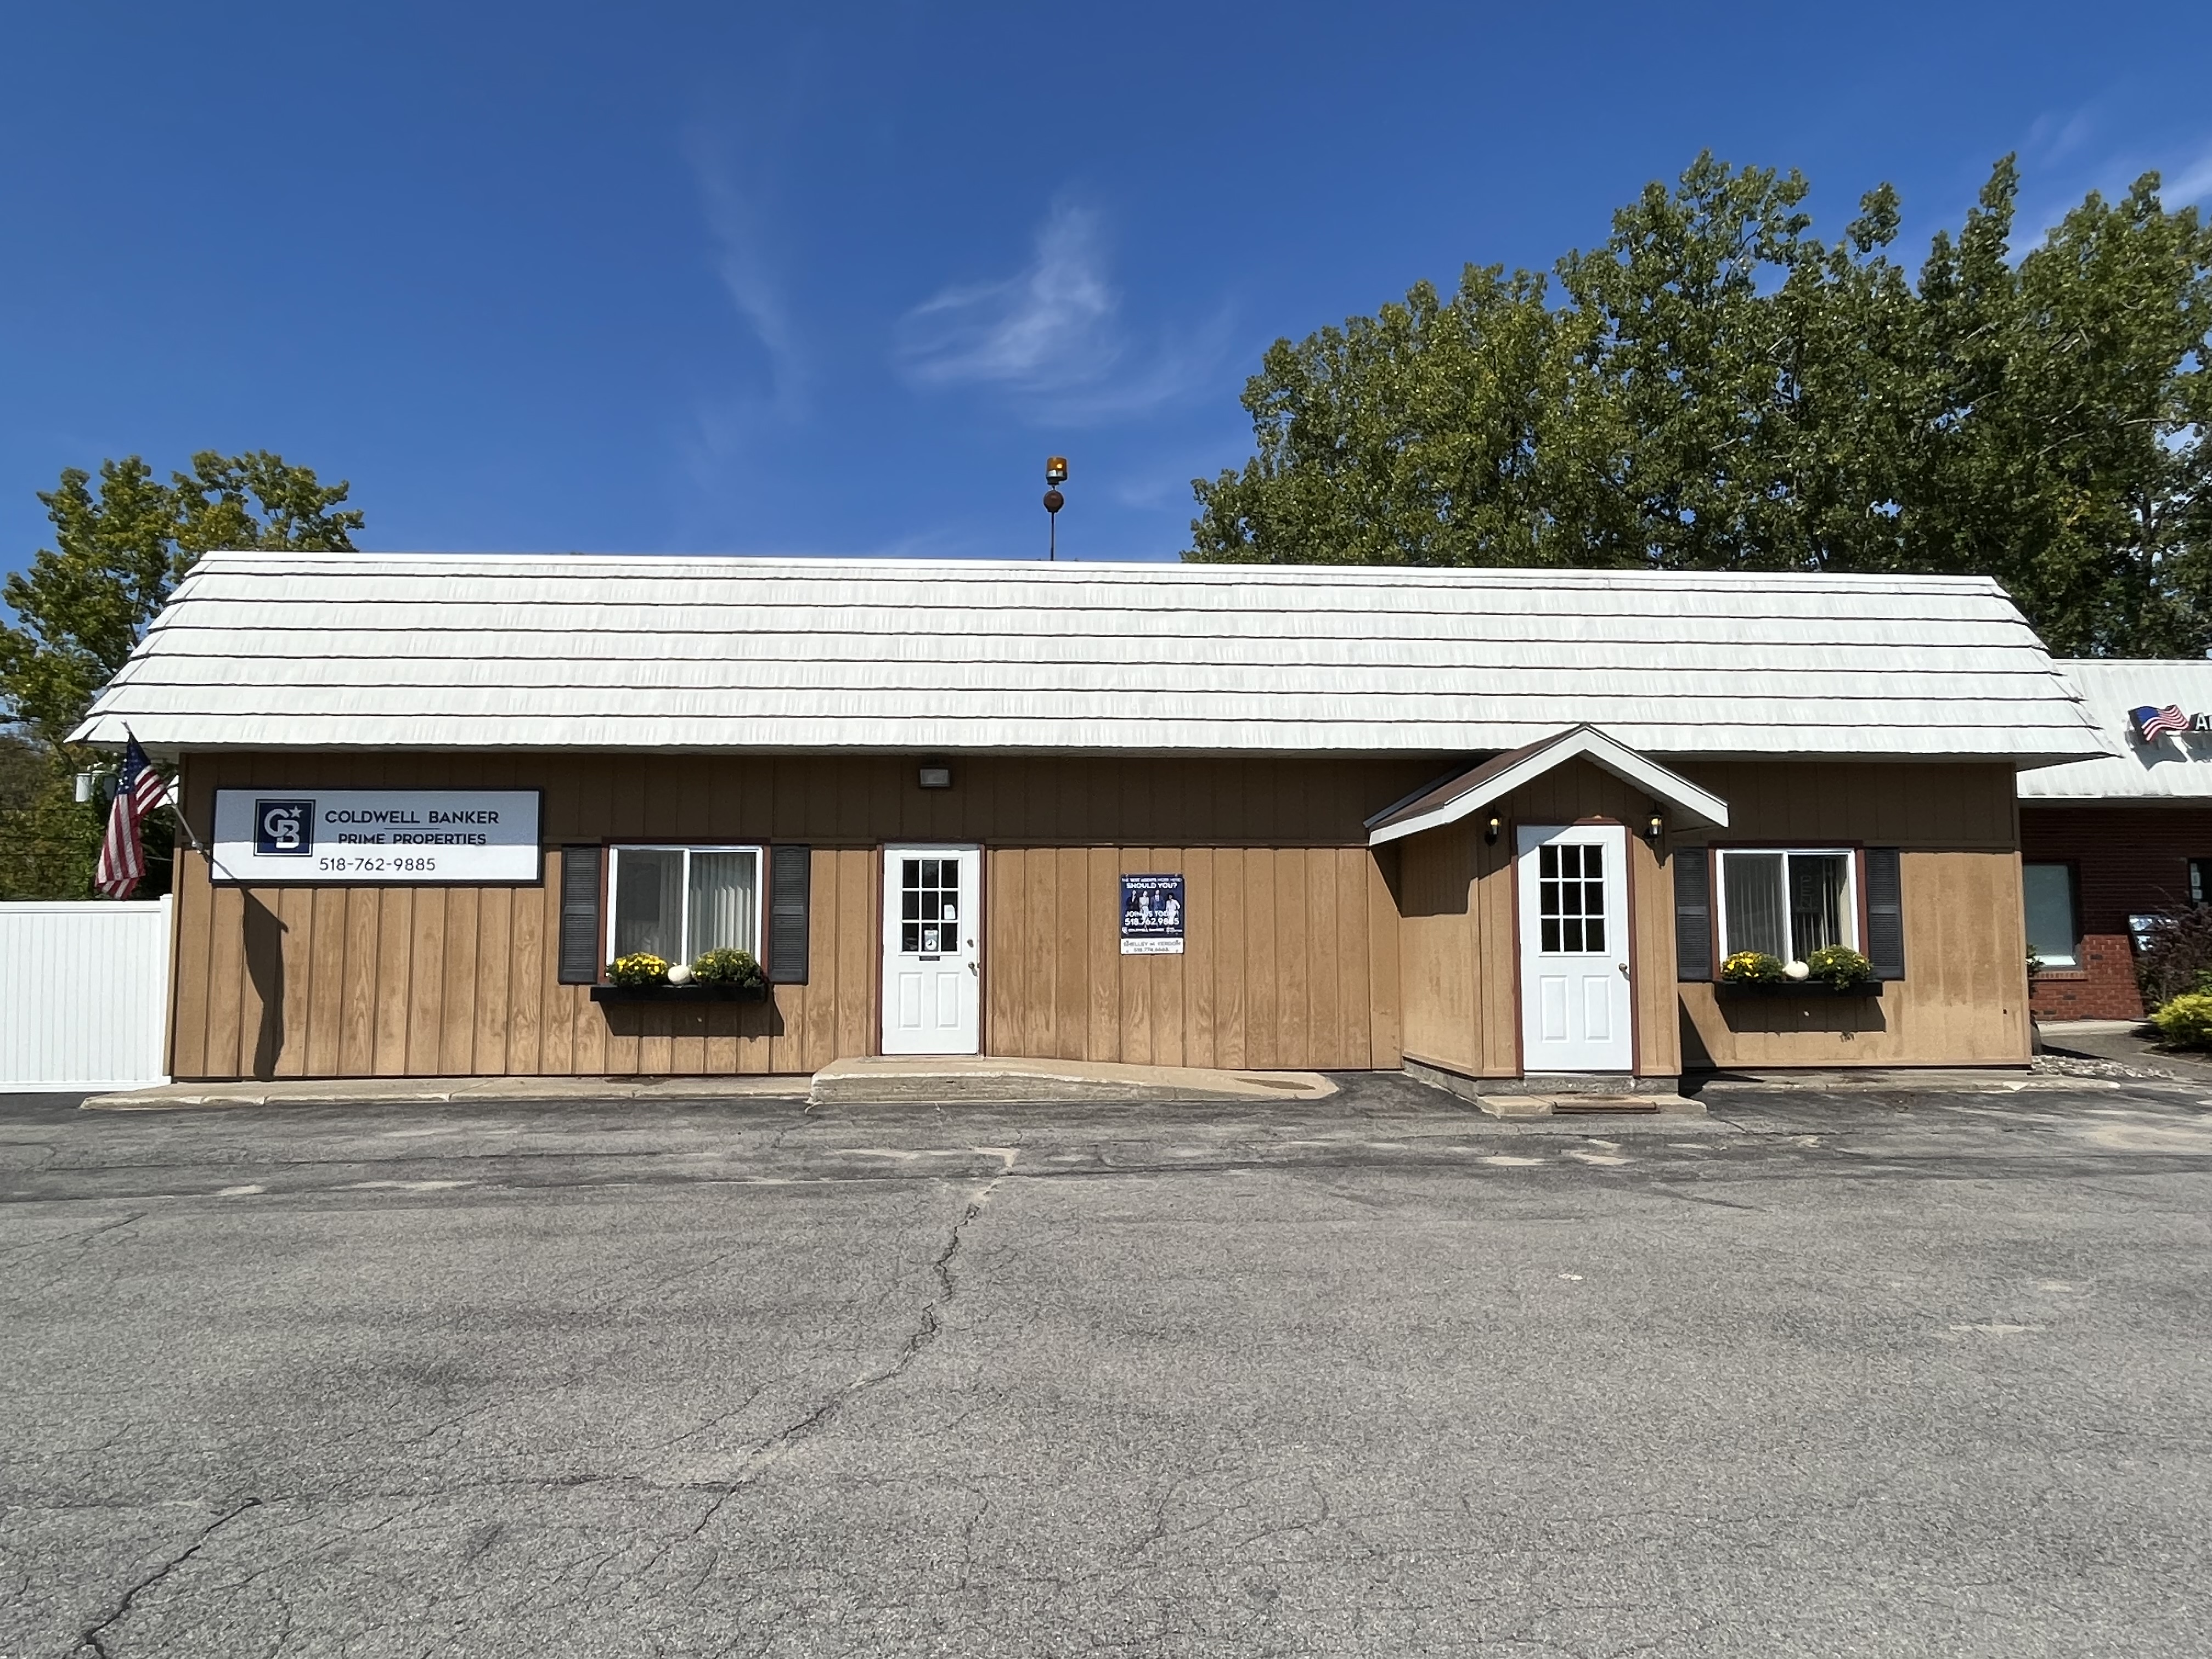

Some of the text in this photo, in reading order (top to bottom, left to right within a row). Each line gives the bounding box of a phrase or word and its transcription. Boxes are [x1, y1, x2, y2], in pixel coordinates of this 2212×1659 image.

[325, 810, 499, 823] COLDWELL BANKER
[338, 833, 487, 845] PRIME PROPERTIES
[319, 857, 436, 871] 518-762-9885
